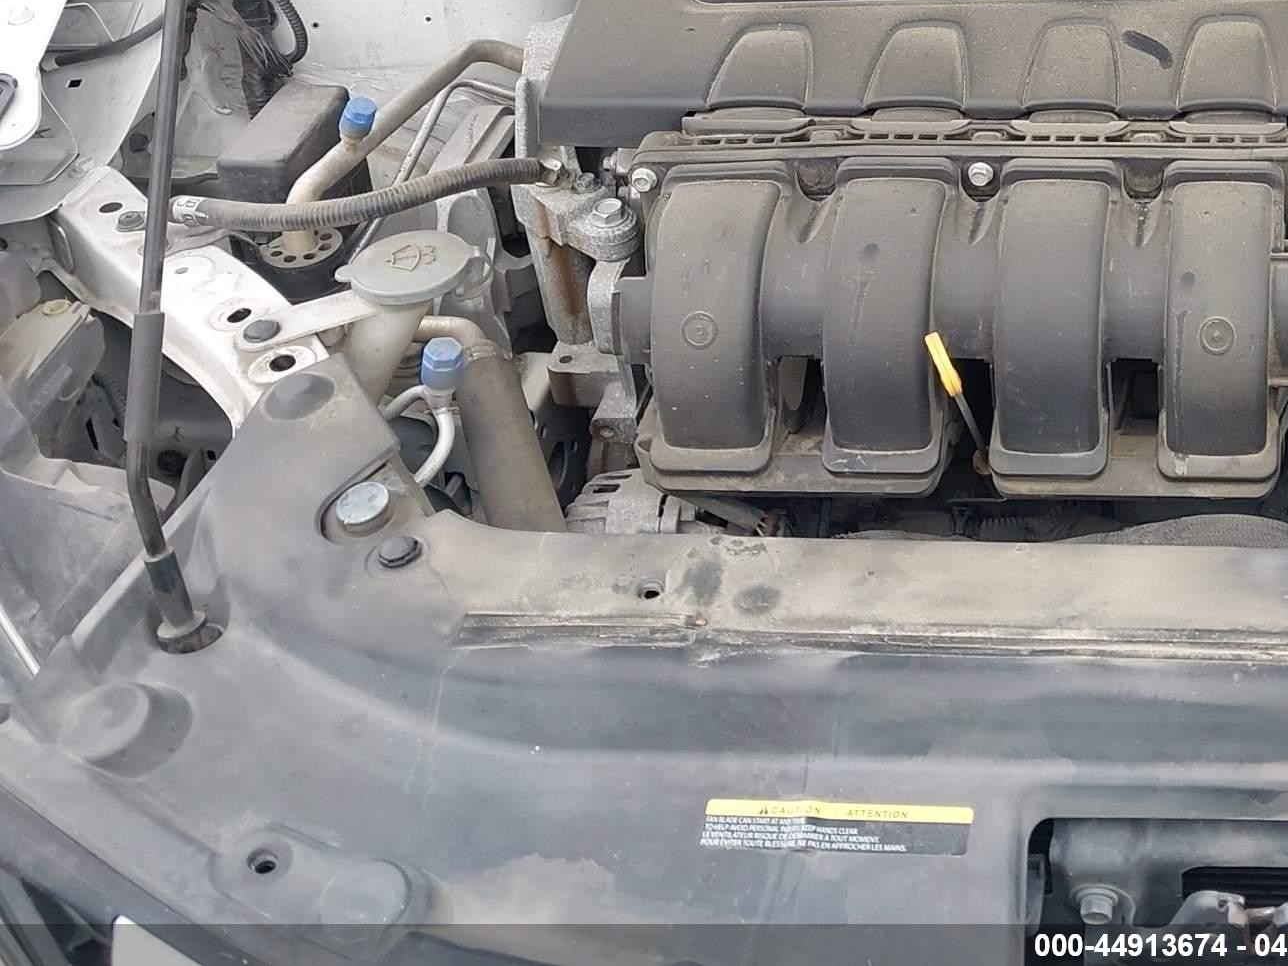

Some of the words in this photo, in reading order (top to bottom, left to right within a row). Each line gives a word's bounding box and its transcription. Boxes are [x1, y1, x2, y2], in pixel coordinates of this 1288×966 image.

[770, 806, 820, 814] CAUTON
[846, 809, 910, 818] ATTENTION
[714, 823, 729, 831] HELP
[730, 824, 749, 832] AVOID
[749, 824, 779, 832] PERSONAL
[801, 825, 816, 833] KEEP
[816, 826, 838, 834] HANDS
[711, 831, 753, 839] VENTILATEUR
[755, 832, 778, 840] RISQUE
[700, 838, 719, 846] POUR
[742, 839, 763, 847] TOUTE
[807, 841, 820, 849] PAS
[831, 842, 871, 851] APPROCHER
